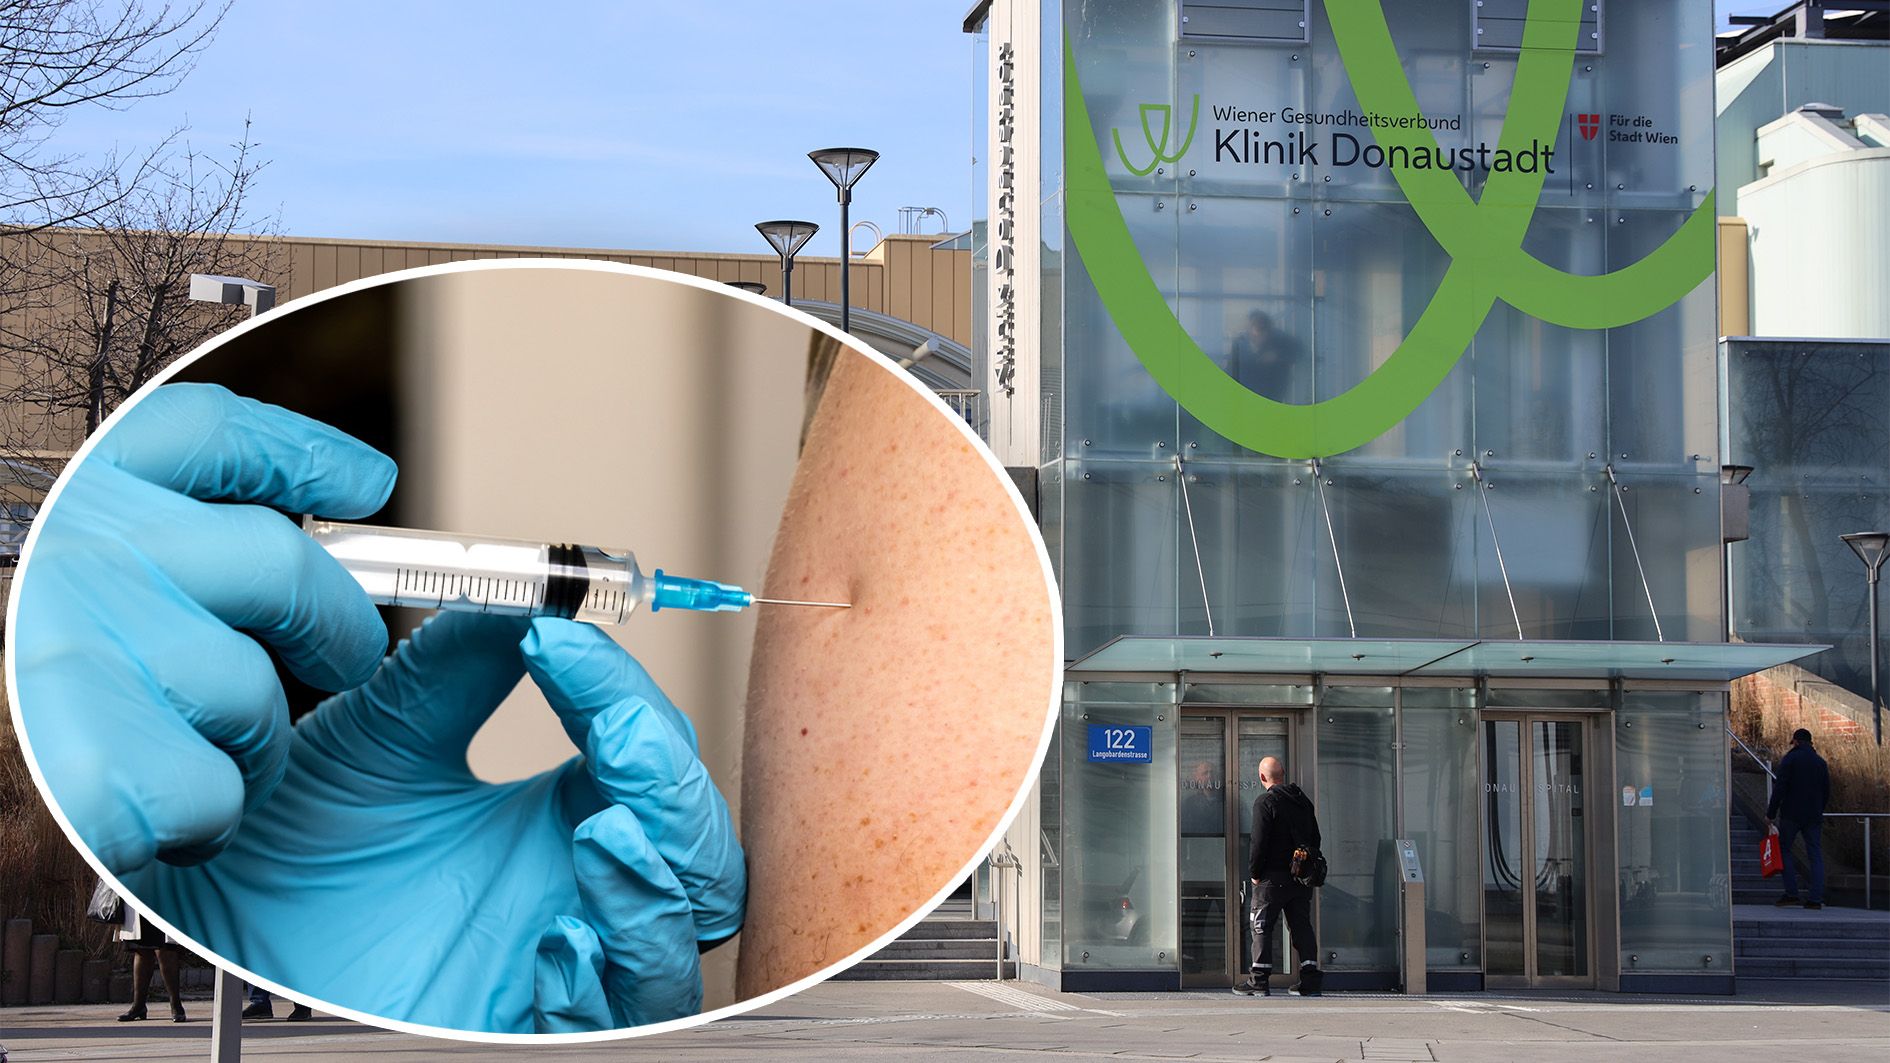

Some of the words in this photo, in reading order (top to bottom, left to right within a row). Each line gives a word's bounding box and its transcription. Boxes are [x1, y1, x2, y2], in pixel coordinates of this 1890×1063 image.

[1212, 105, 1276, 123] Wiener
[1281, 107, 1461, 130] Gesundheitsverbund
[1609, 114, 1631, 126] Für
[1633, 116, 1653, 127] die
[1609, 130, 1643, 142] Stadt
[1645, 132, 1678, 144] Wien
[1215, 129, 1319, 166] Klinik
[1332, 133, 1555, 174] Donaustadt
[1104, 729, 1135, 749] 122
[1092, 750, 1148, 759] Langobardenstrasse
[1484, 783, 1516, 793] ONAU
[1537, 784, 1579, 794] SPITAL
